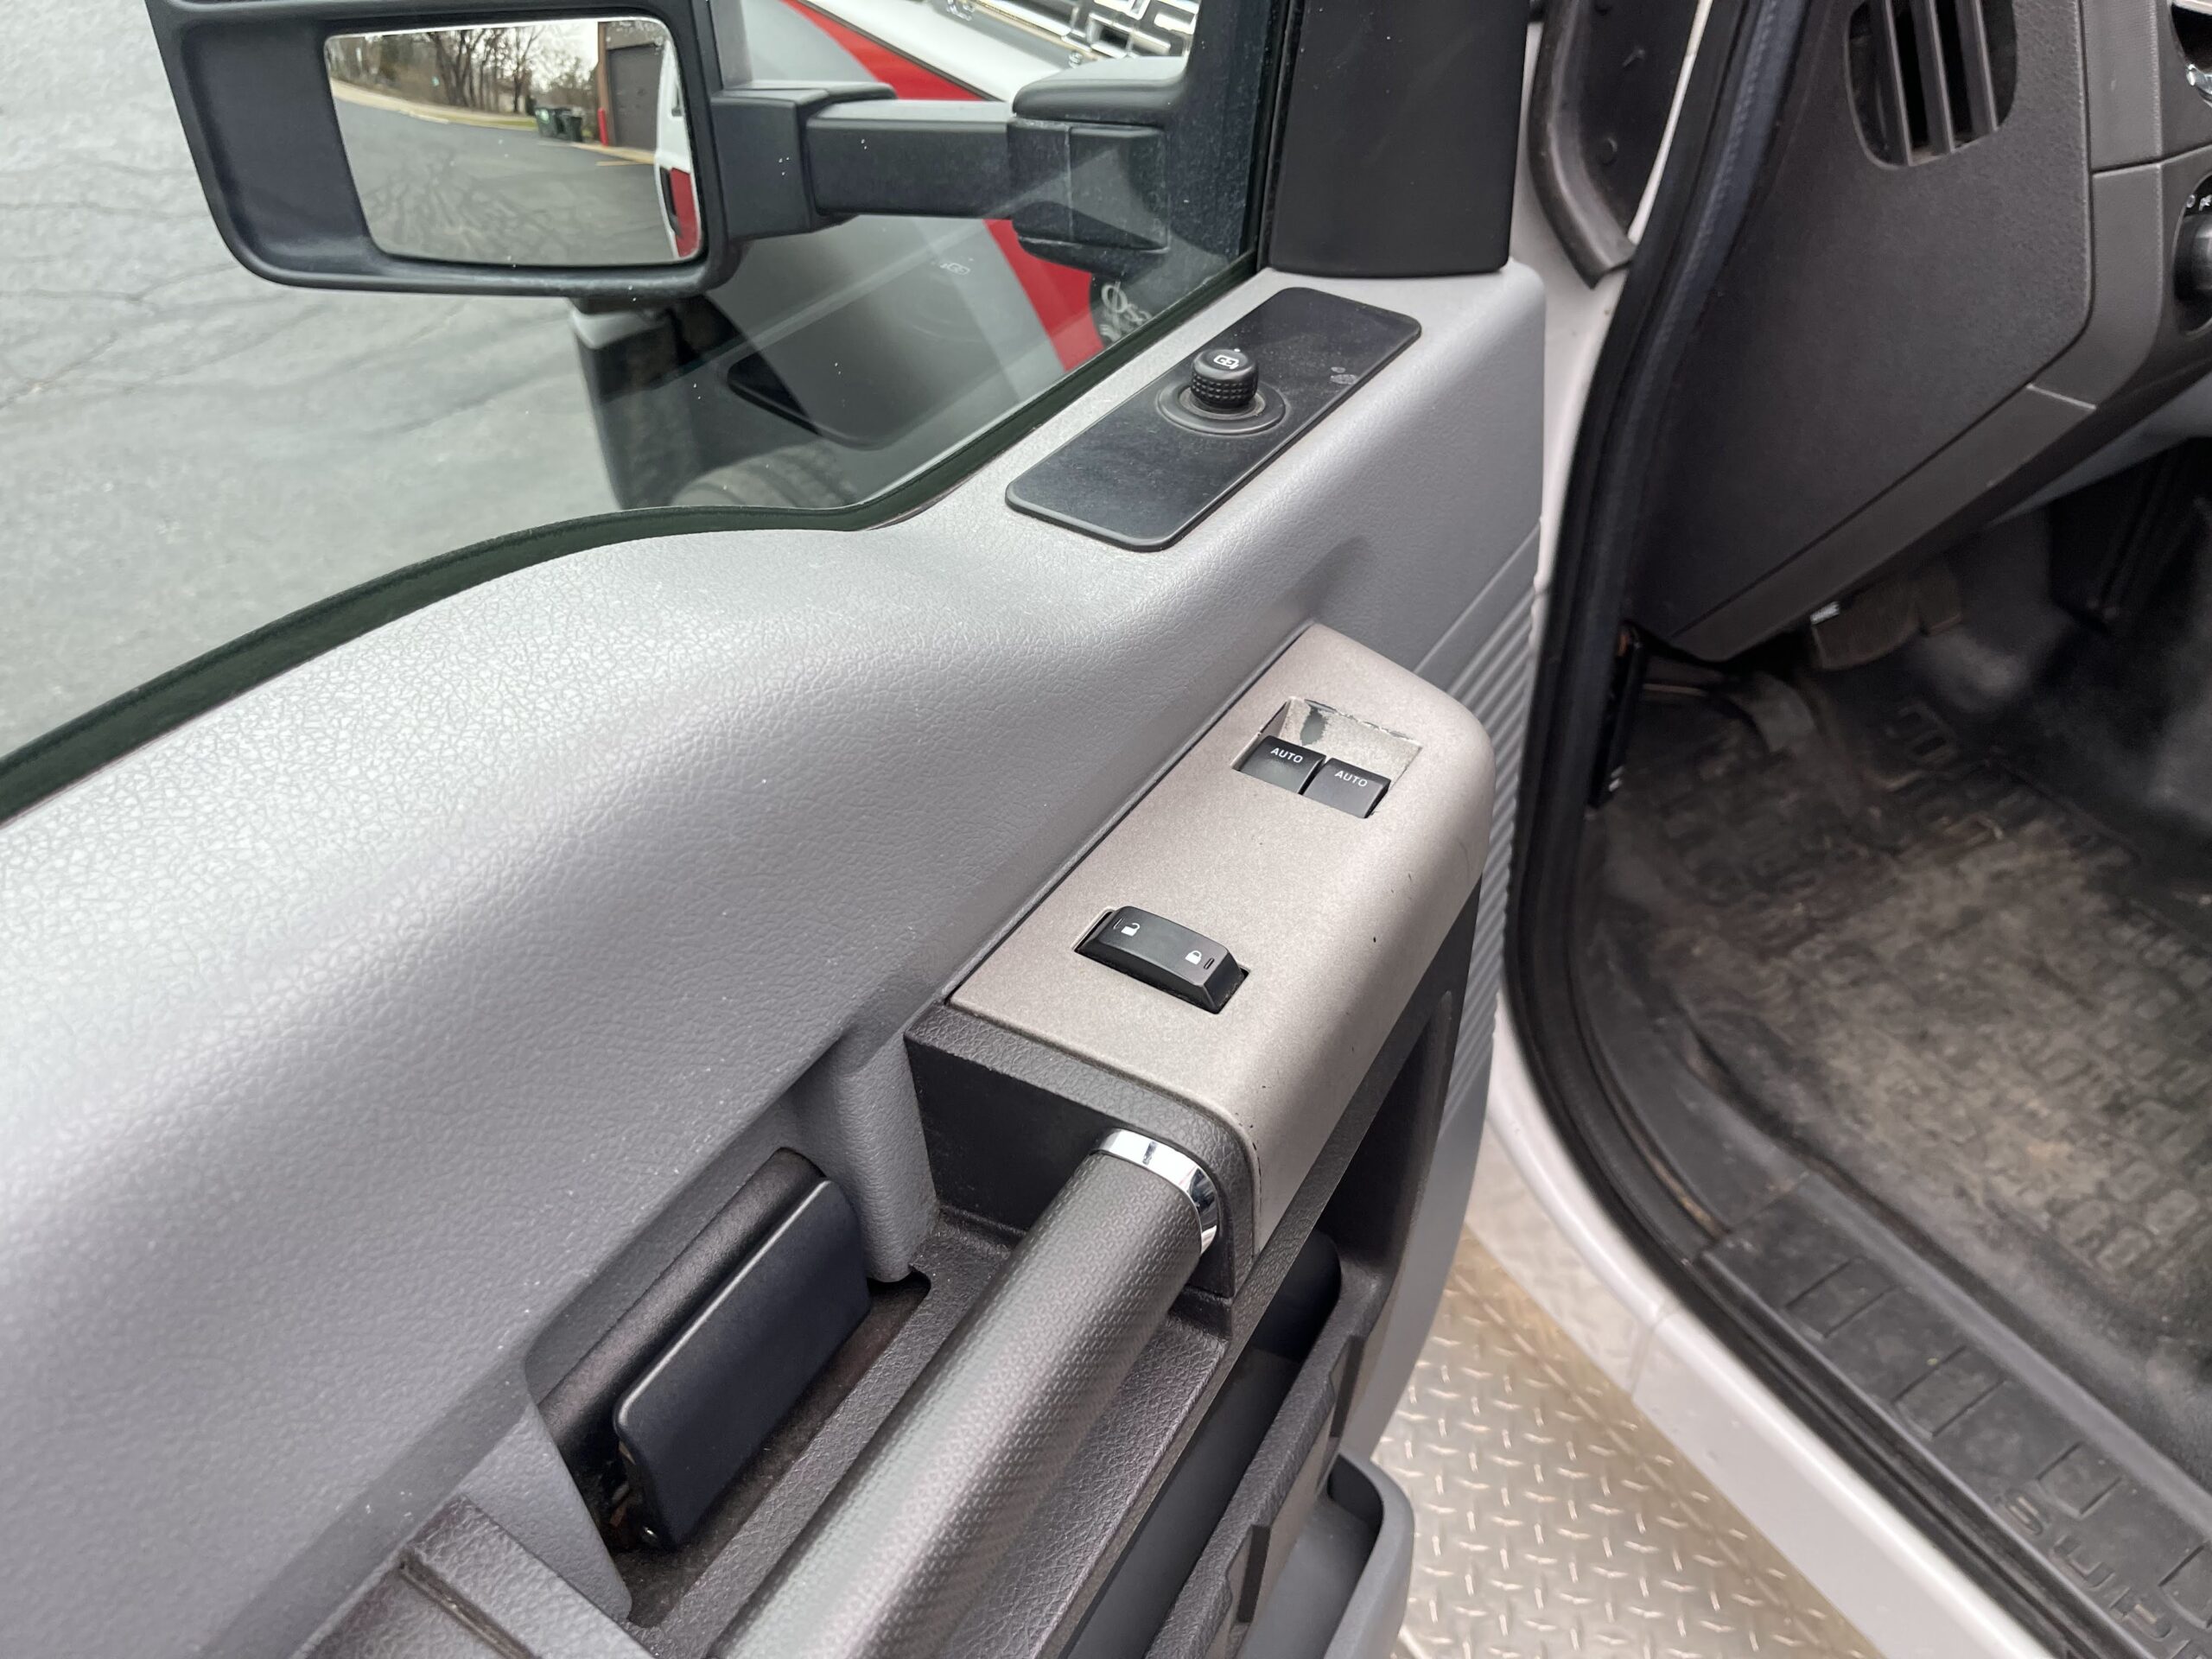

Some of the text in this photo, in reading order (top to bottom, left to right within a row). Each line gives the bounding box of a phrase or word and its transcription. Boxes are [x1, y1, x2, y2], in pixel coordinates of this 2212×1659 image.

[1270, 747, 1303, 764] AUTO
[1334, 770, 1367, 787] AUTO
[2001, 1488, 2200, 1658] SUP
